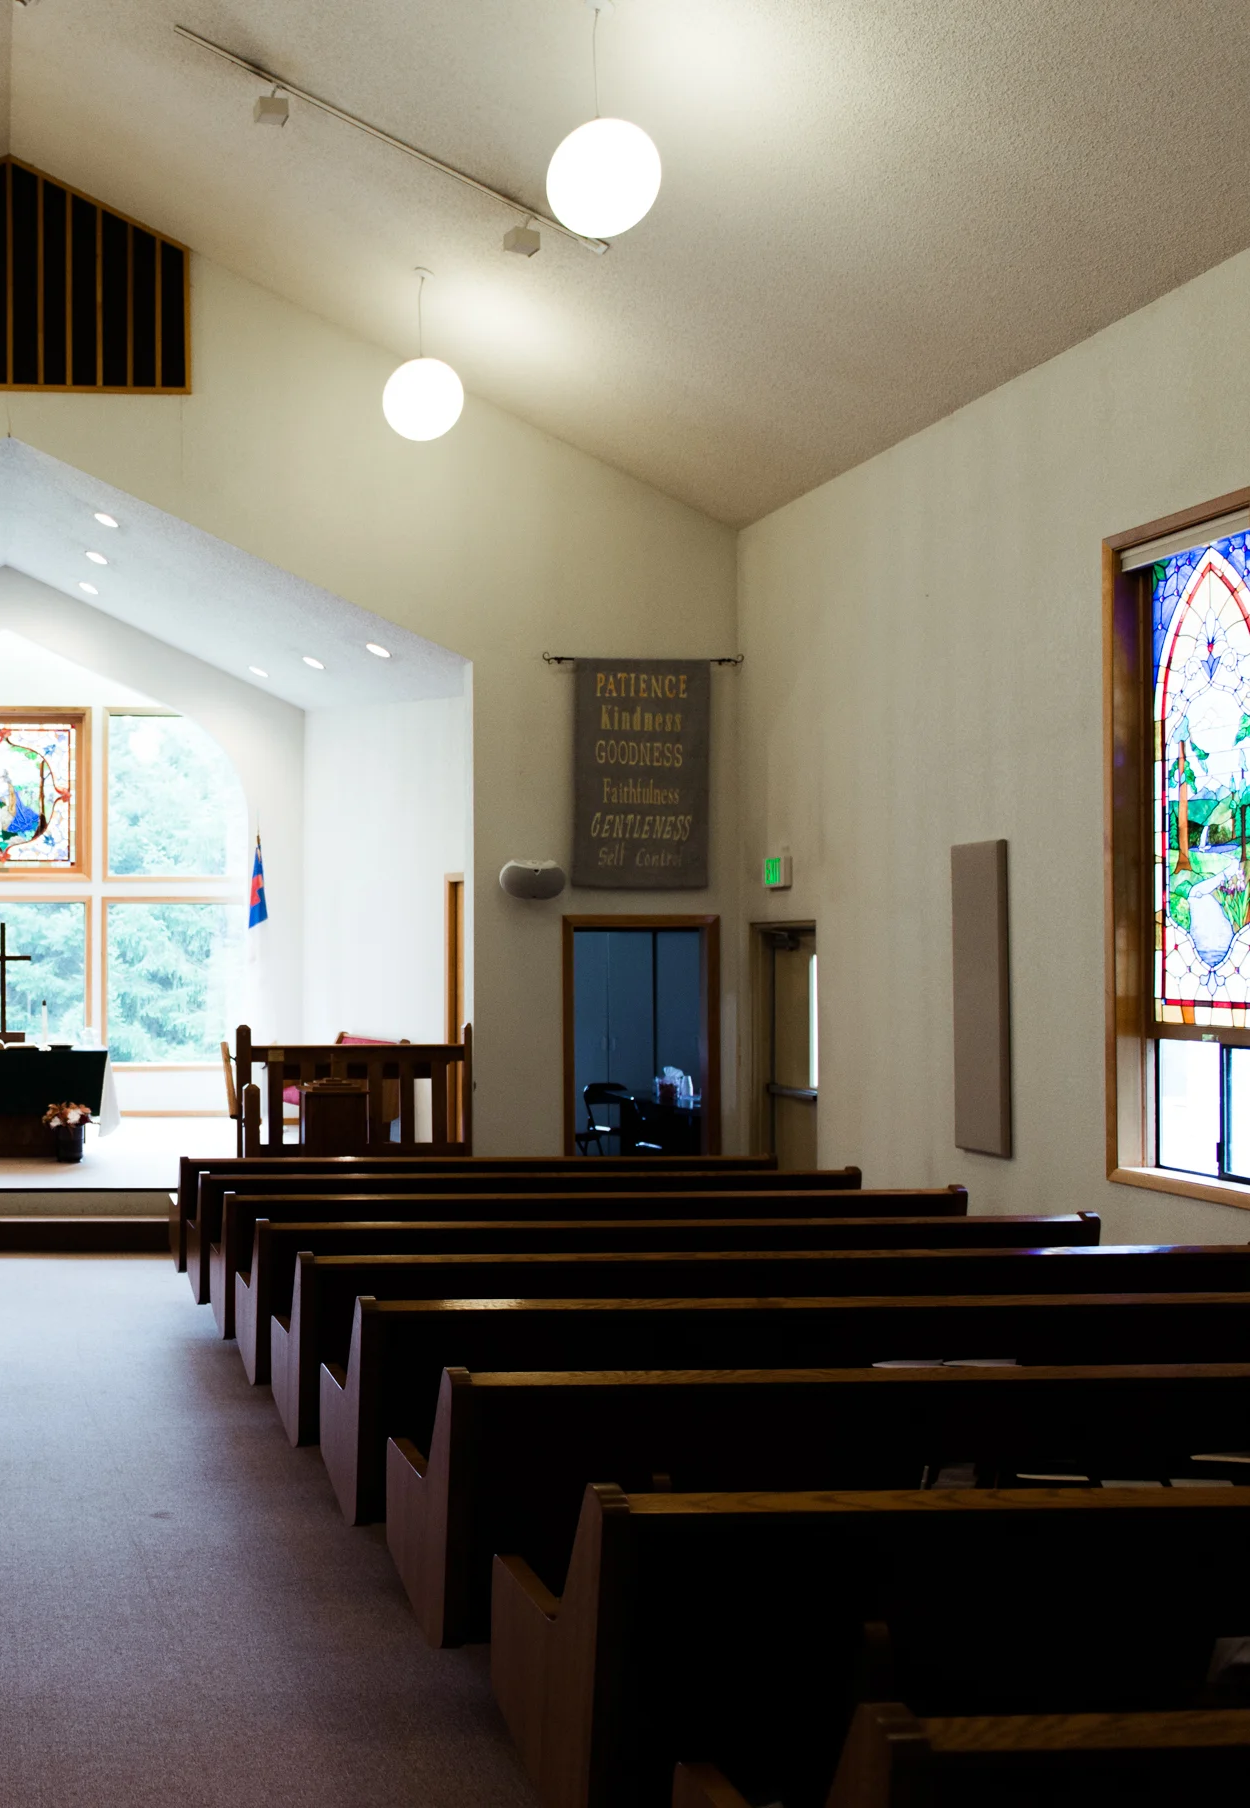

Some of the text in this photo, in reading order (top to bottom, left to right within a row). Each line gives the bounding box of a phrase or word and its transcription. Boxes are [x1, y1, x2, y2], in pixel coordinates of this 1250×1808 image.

[596, 673, 688, 698] PATIENCE
[601, 704, 682, 731] Kindness
[596, 740, 683, 768] GOODNESS
[603, 778, 680, 805] Faithfulness
[590, 812, 692, 841] GENTLENESS
